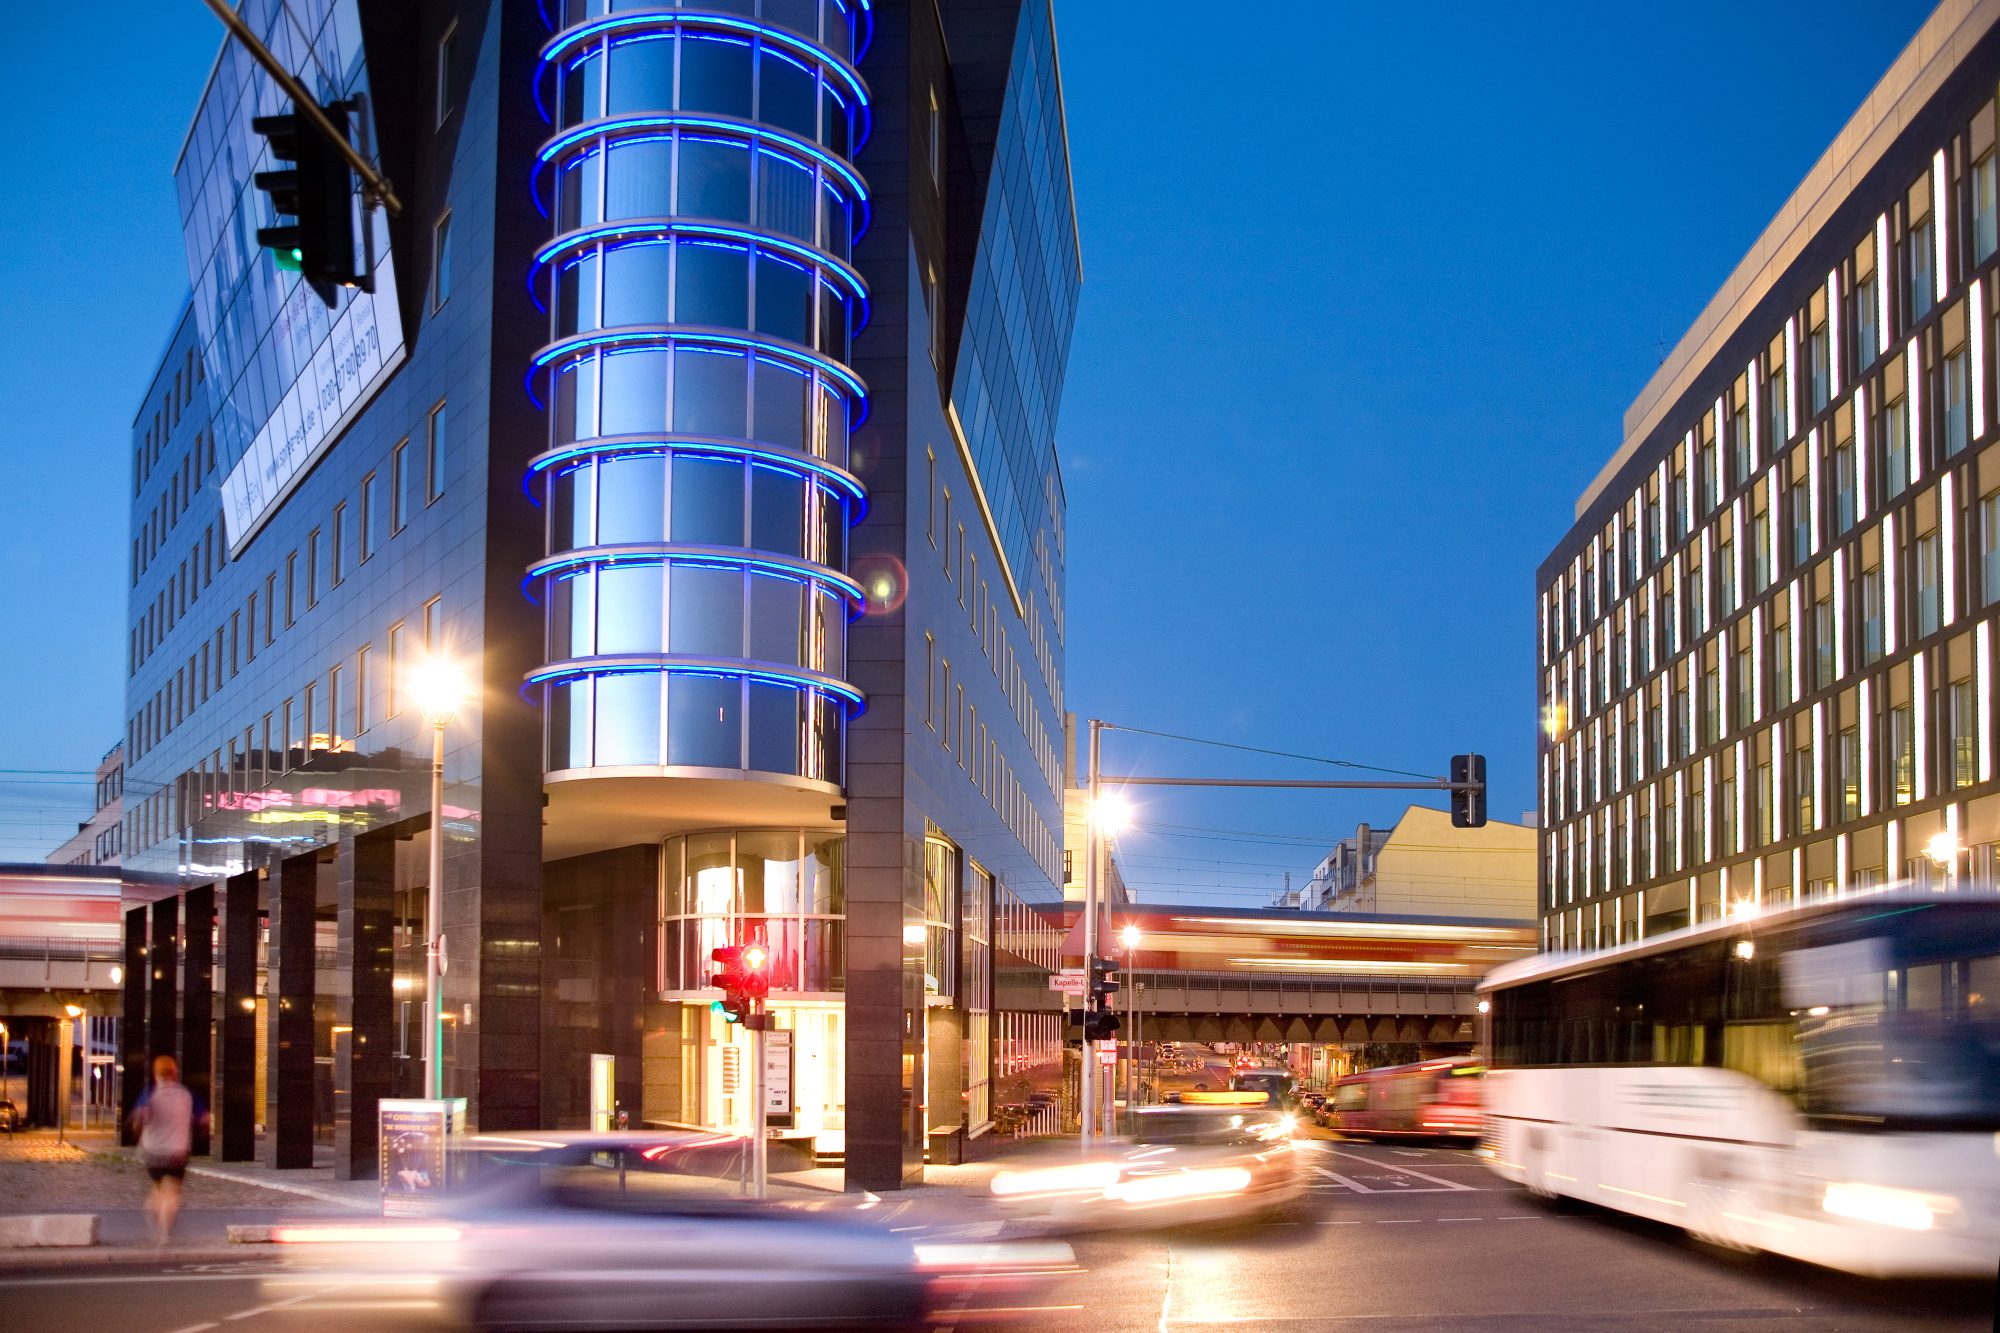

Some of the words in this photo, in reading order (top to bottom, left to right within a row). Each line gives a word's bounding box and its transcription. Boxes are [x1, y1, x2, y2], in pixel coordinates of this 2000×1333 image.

[321, 363, 345, 411] 030-27
[346, 352, 356, 381] 90
[355, 339, 366, 369] 89
[365, 325, 377, 357] 70
